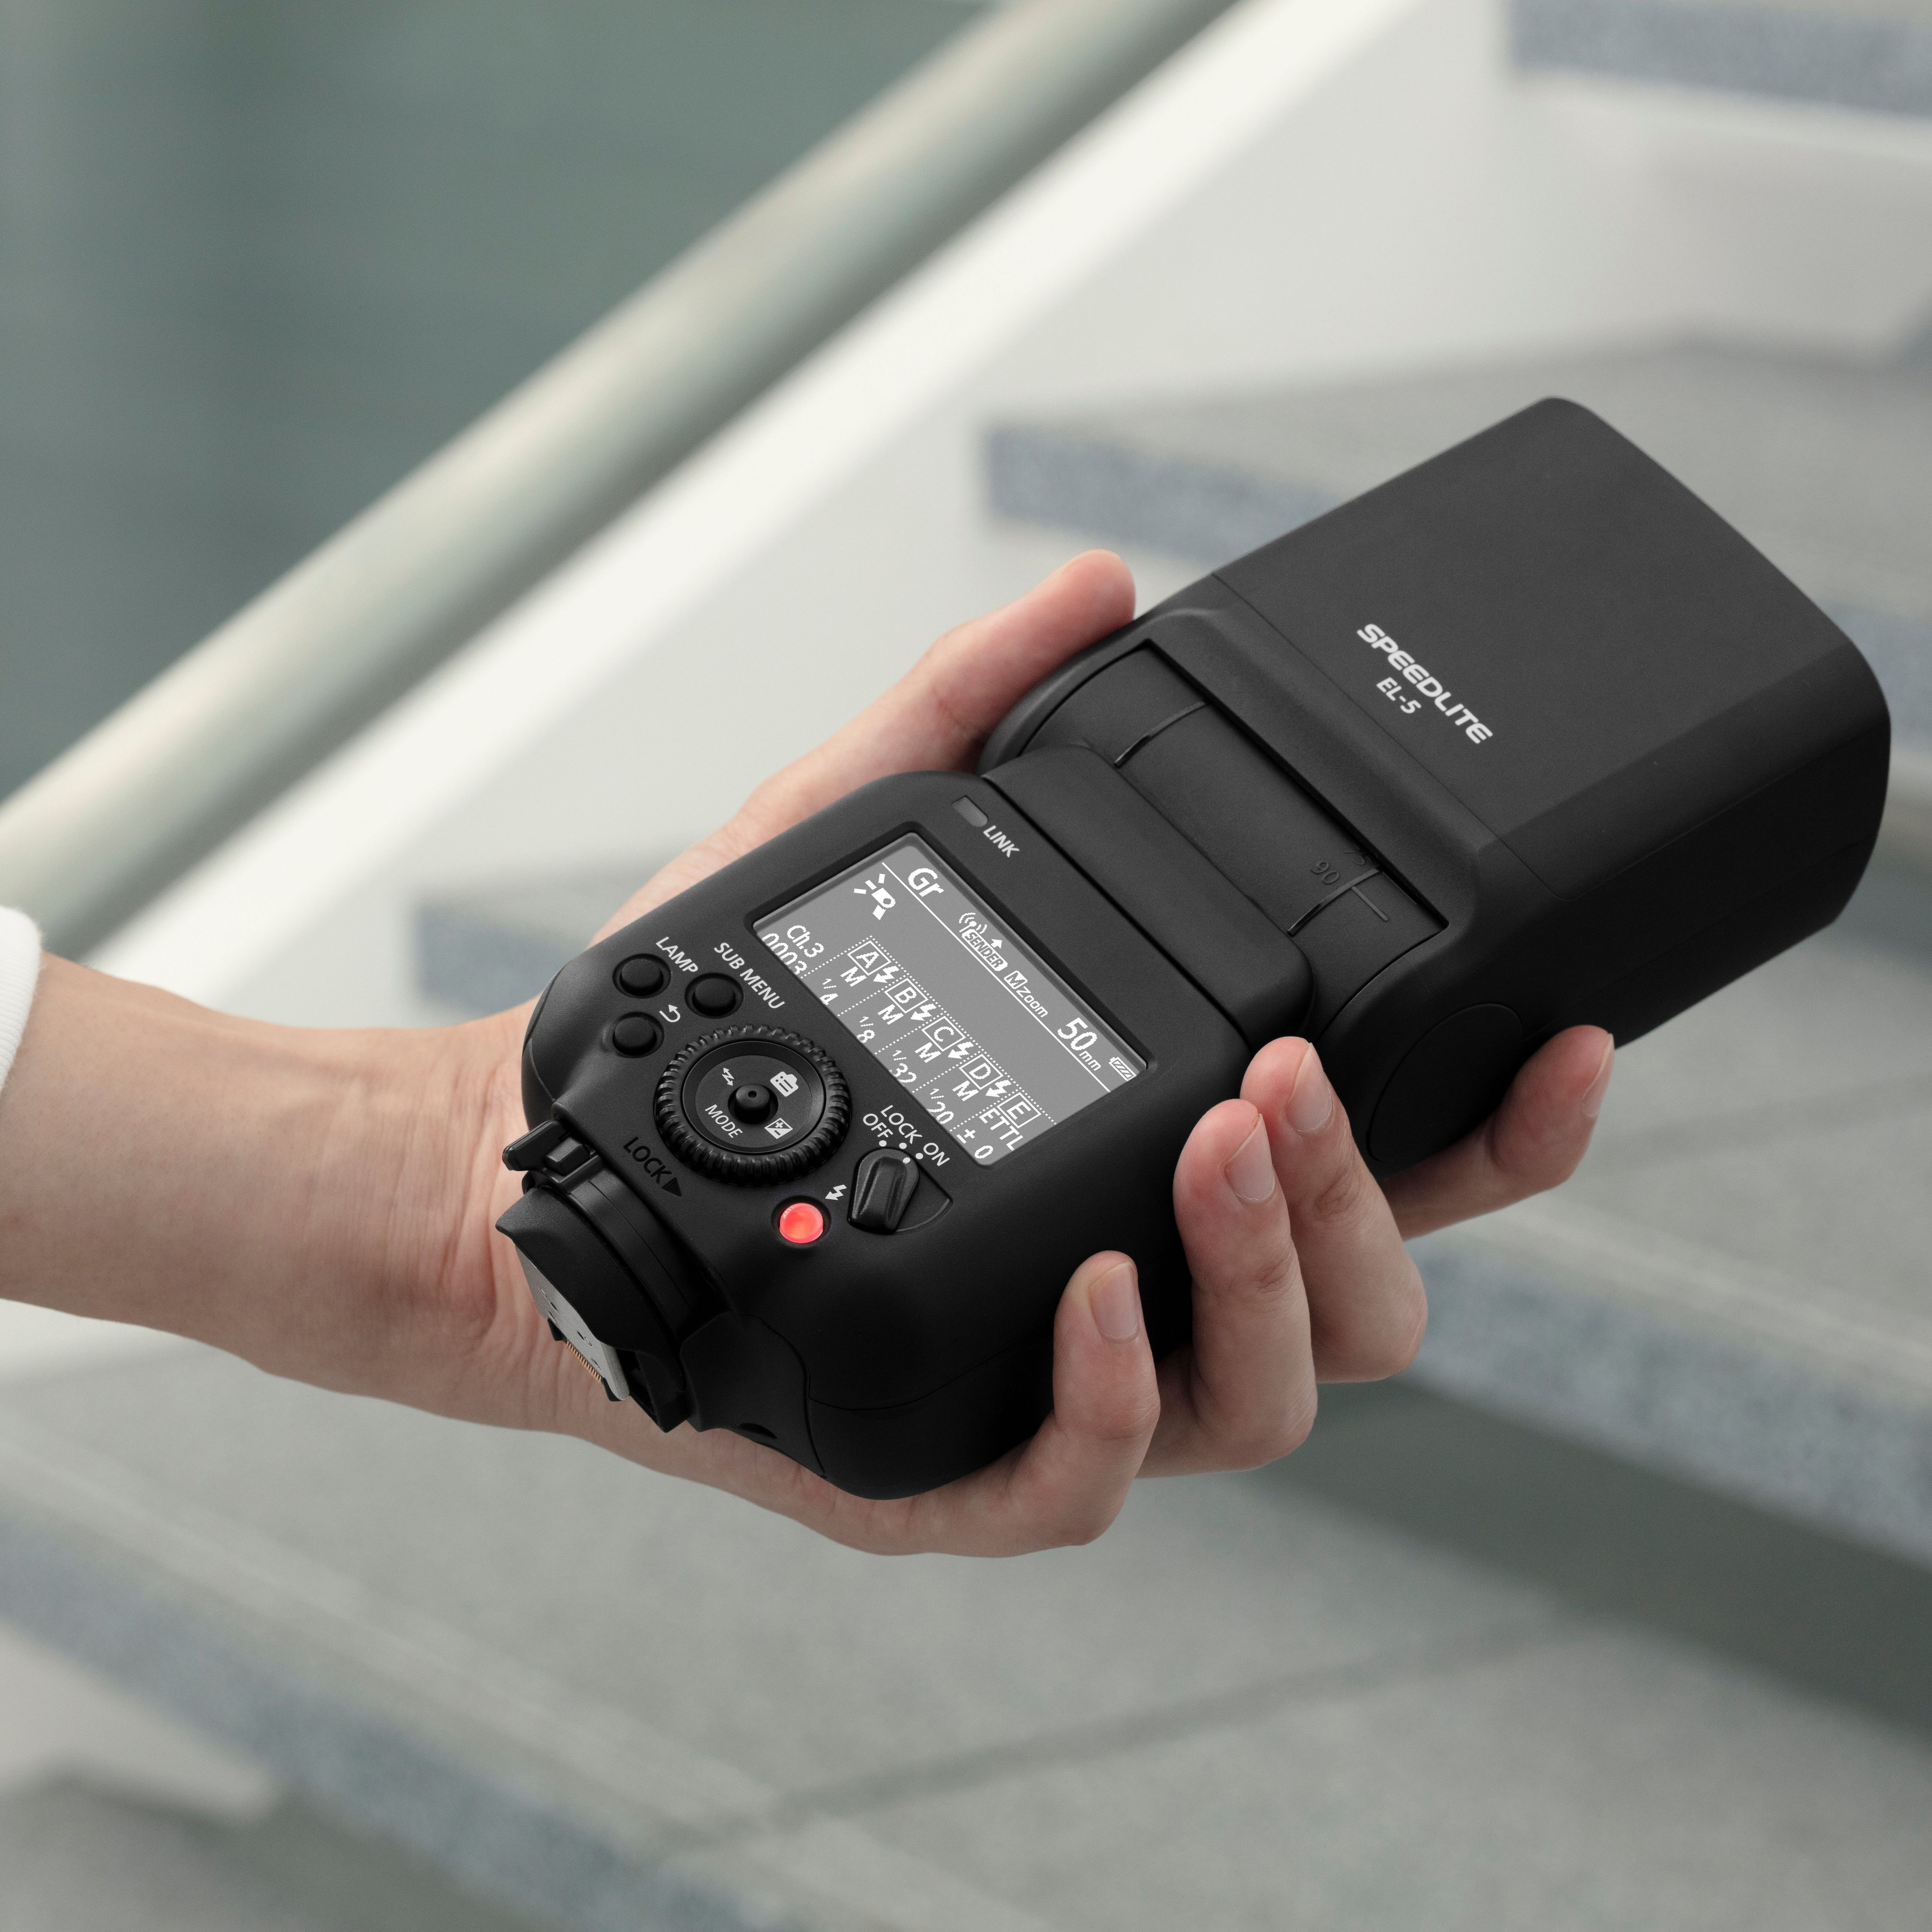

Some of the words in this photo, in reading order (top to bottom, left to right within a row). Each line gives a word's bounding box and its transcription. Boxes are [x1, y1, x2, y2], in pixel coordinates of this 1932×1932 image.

[1356, 623, 1493, 744] SPEEDLITE
[1376, 677, 1422, 714] EL-5
[983, 825, 1020, 858] LINK
[1310, 860, 1340, 885] 90
[908, 868, 945, 897] Gr
[964, 931, 1004, 969] SENDER
[656, 936, 699, 972] LAMP
[761, 933, 808, 975] 0003
[787, 925, 825, 958] Ch.3
[714, 942, 745, 969] SUB
[739, 968, 785, 1009] MENU
[855, 951, 880, 969] A
[894, 986, 917, 1004] B
[933, 1026, 954, 1042] C
[969, 1062, 991, 1080] D
[1006, 1101, 1032, 1120] E
[856, 1016, 875, 1043] 1/8
[840, 966, 867, 987] M
[877, 1004, 904, 1025] M
[914, 1042, 942, 1063] M
[952, 1080, 979, 1102] M
[979, 1107, 1024, 1151] ETTL
[705, 1104, 743, 1138] MODE
[863, 1113, 893, 1138] OFF
[880, 1105, 923, 1144] LOCK
[623, 1137, 671, 1183] LOCK
[923, 1142, 950, 1166] ON
